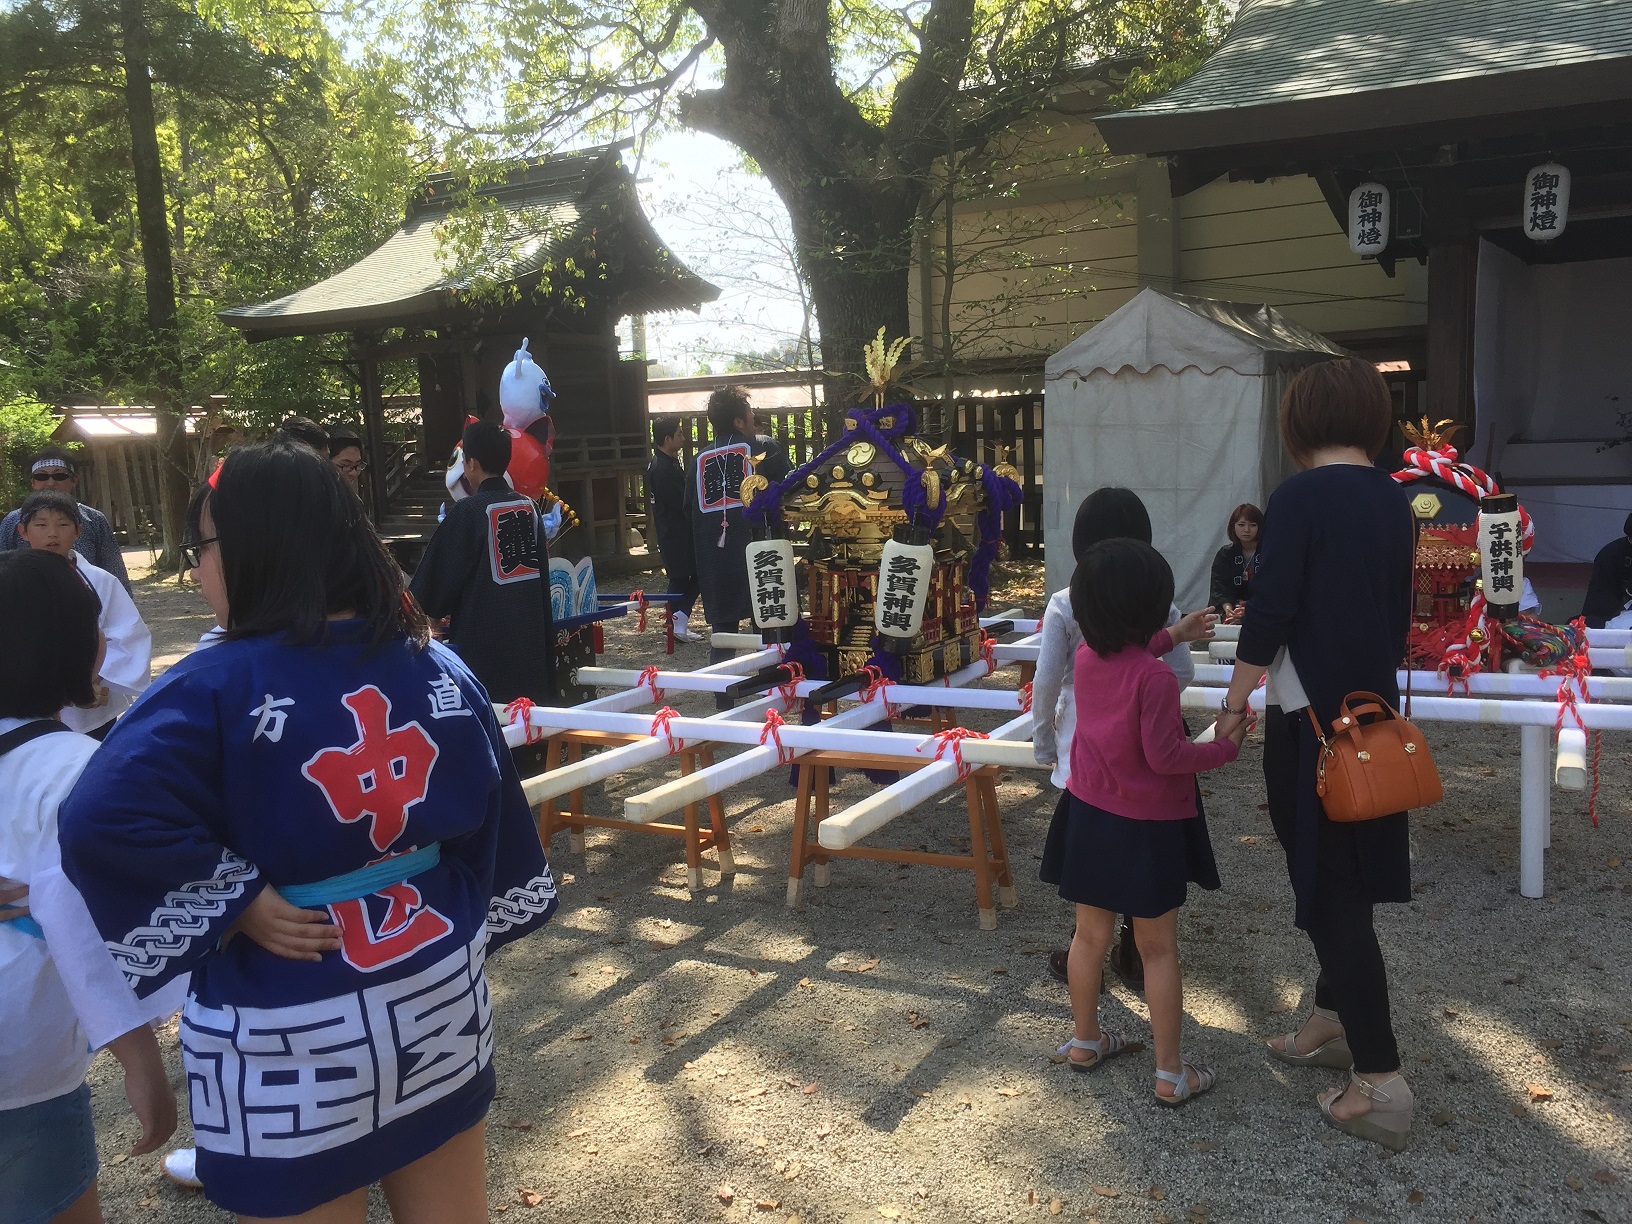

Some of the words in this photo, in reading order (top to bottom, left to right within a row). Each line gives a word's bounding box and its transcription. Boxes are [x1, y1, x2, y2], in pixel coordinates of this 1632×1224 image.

[1357, 190, 1383, 246] 御神燈
[1530, 172, 1559, 232] 御神燈
[753, 550, 788, 622] 多賀神輿
[1489, 521, 1514, 593] 子供神輿
[882, 555, 921, 631] 多賀神輿
[249, 693, 295, 743] 方
[427, 673, 472, 719] 直
